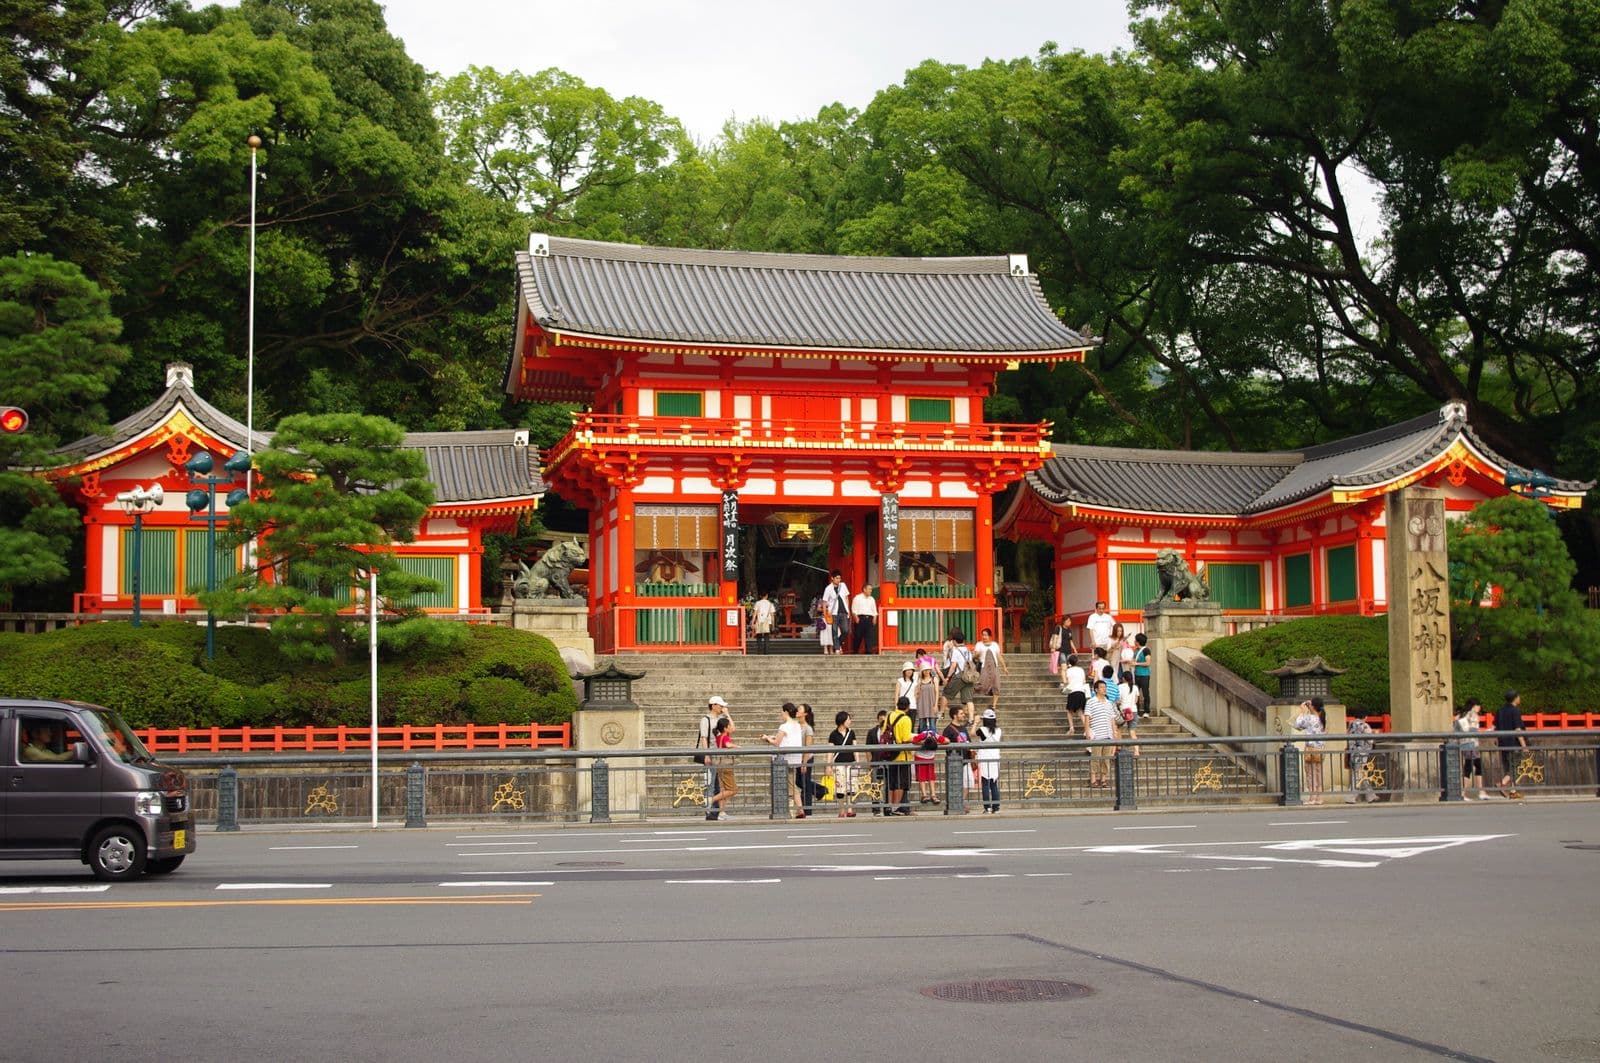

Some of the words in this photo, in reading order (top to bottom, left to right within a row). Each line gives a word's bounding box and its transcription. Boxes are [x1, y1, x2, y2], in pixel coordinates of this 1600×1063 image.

[725, 534, 738, 571] 月次祭
[885, 533, 898, 571] 七夕祭
[1409, 561, 1448, 706] 八坂神社
